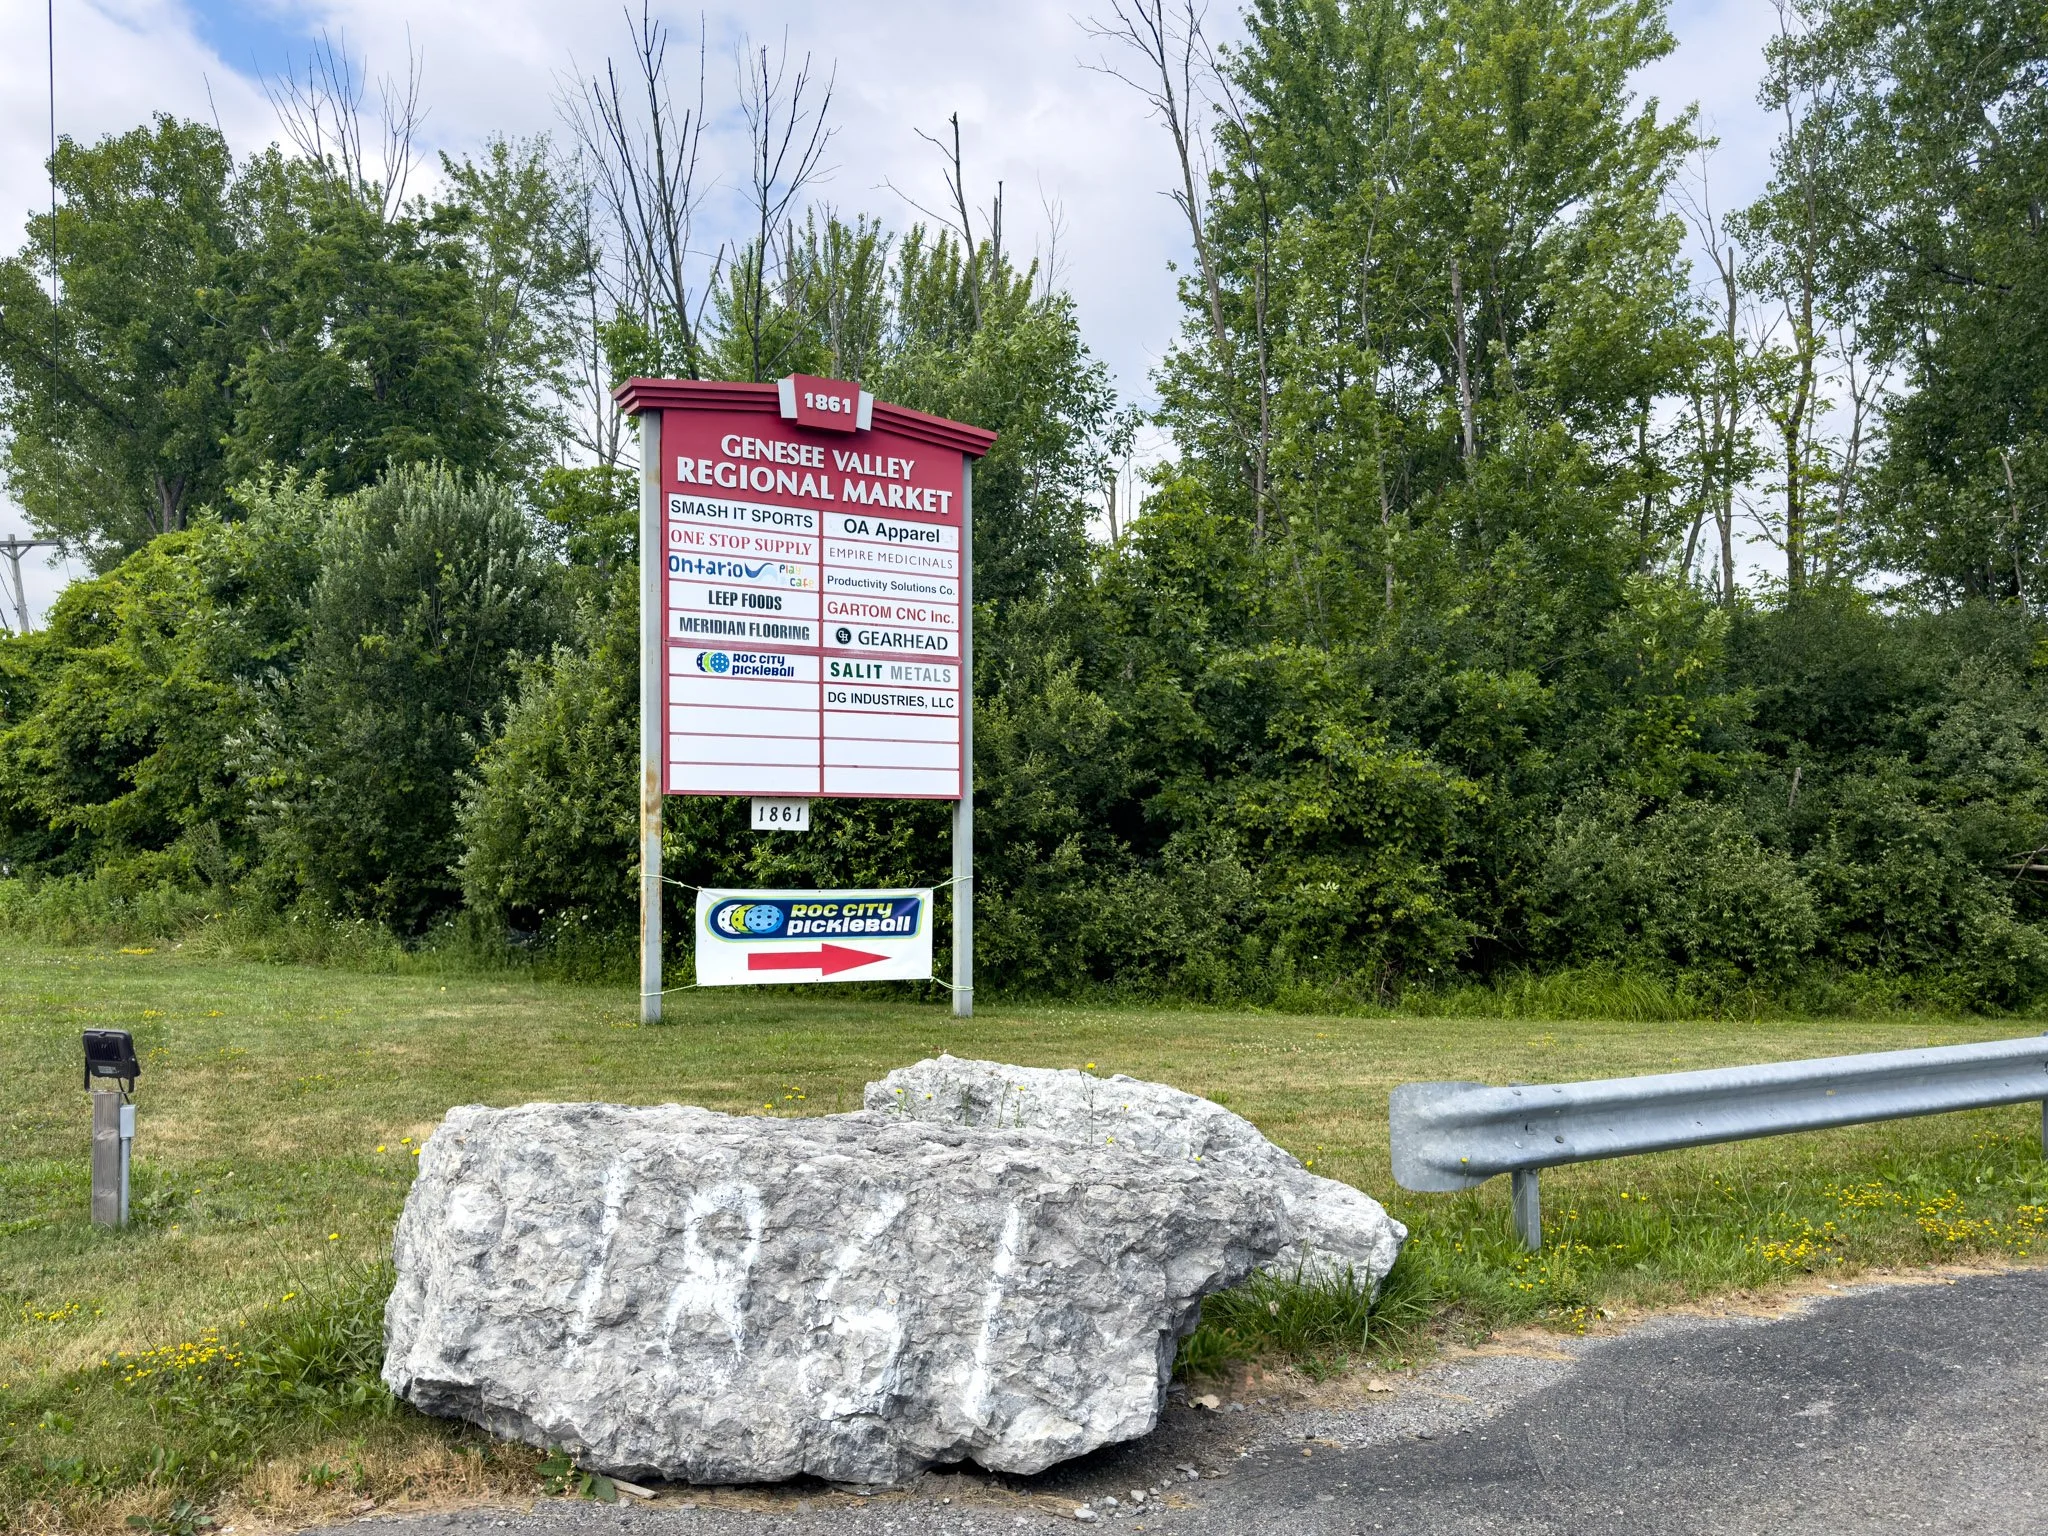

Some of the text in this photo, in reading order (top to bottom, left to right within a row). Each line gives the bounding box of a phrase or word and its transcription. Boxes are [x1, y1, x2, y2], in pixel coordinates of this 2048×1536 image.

[804, 392, 852, 414] 1861
[721, 434, 915, 481] GENESEE VALLEY
[677, 456, 953, 514] REGIONAL MARKET
[671, 500, 813, 528] SMASH IT SPORTS
[844, 518, 940, 543] OA Apparel
[671, 529, 812, 556] ONE STOP SUPPLY
[669, 555, 743, 578] Ontario
[829, 547, 953, 569] EMPIRE MEDICINALS
[828, 575, 955, 595] Productivity Solutions Co.
[708, 589, 782, 610] LEEP FOODS
[827, 601, 954, 624] GARTOM CNC Inc.
[679, 617, 810, 640] MERIDIAN FLOORING
[858, 630, 948, 650] GEARHEAD
[732, 653, 757, 663] ROC
[830, 662, 951, 683] SALIT METALS
[828, 692, 954, 709] DG INDUSTRIES, LLC
[758, 806, 801, 822] 1861
[790, 904, 840, 918] ROC
[563, 1159, 1026, 1418] 1861
